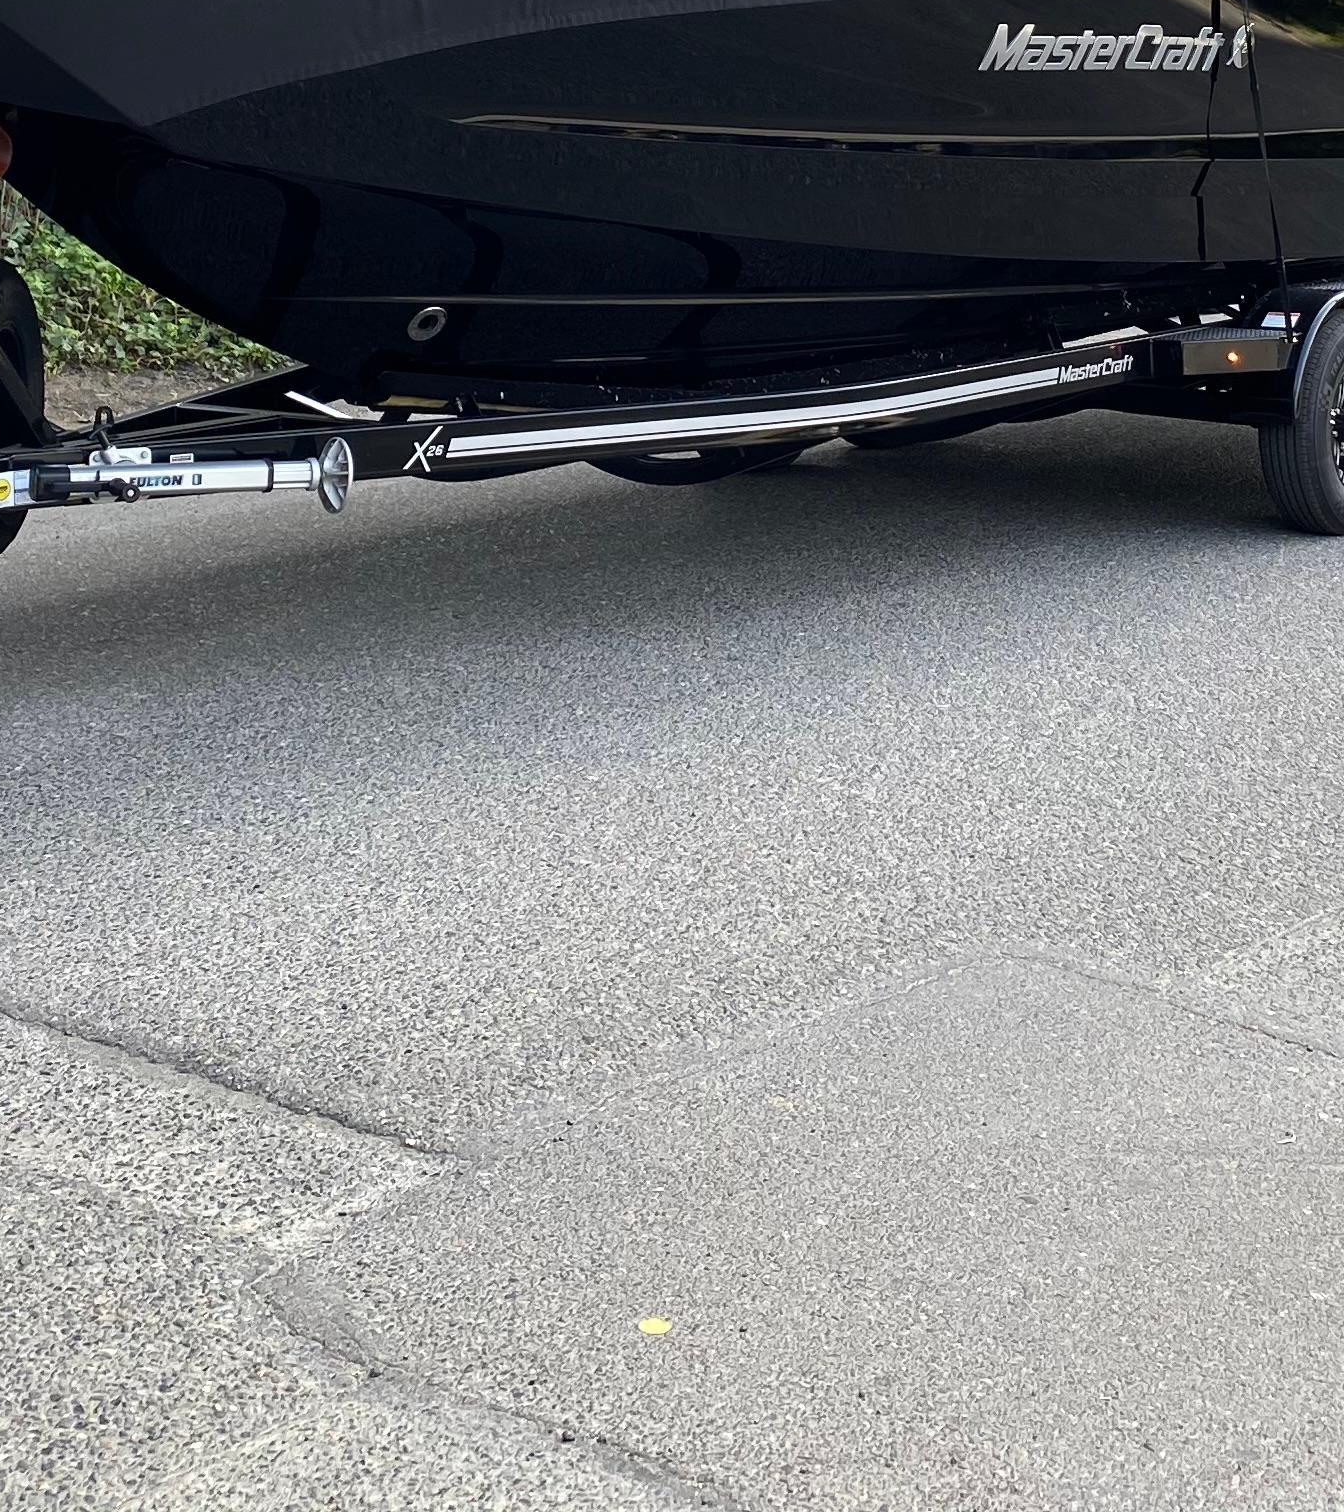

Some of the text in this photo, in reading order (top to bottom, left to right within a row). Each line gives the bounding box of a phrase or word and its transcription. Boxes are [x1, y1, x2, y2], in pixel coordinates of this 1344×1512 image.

[977, 23, 1226, 71] MasterCraft
[1058, 354, 1134, 384] MasterCraft
[129, 474, 184, 487] FULTON
